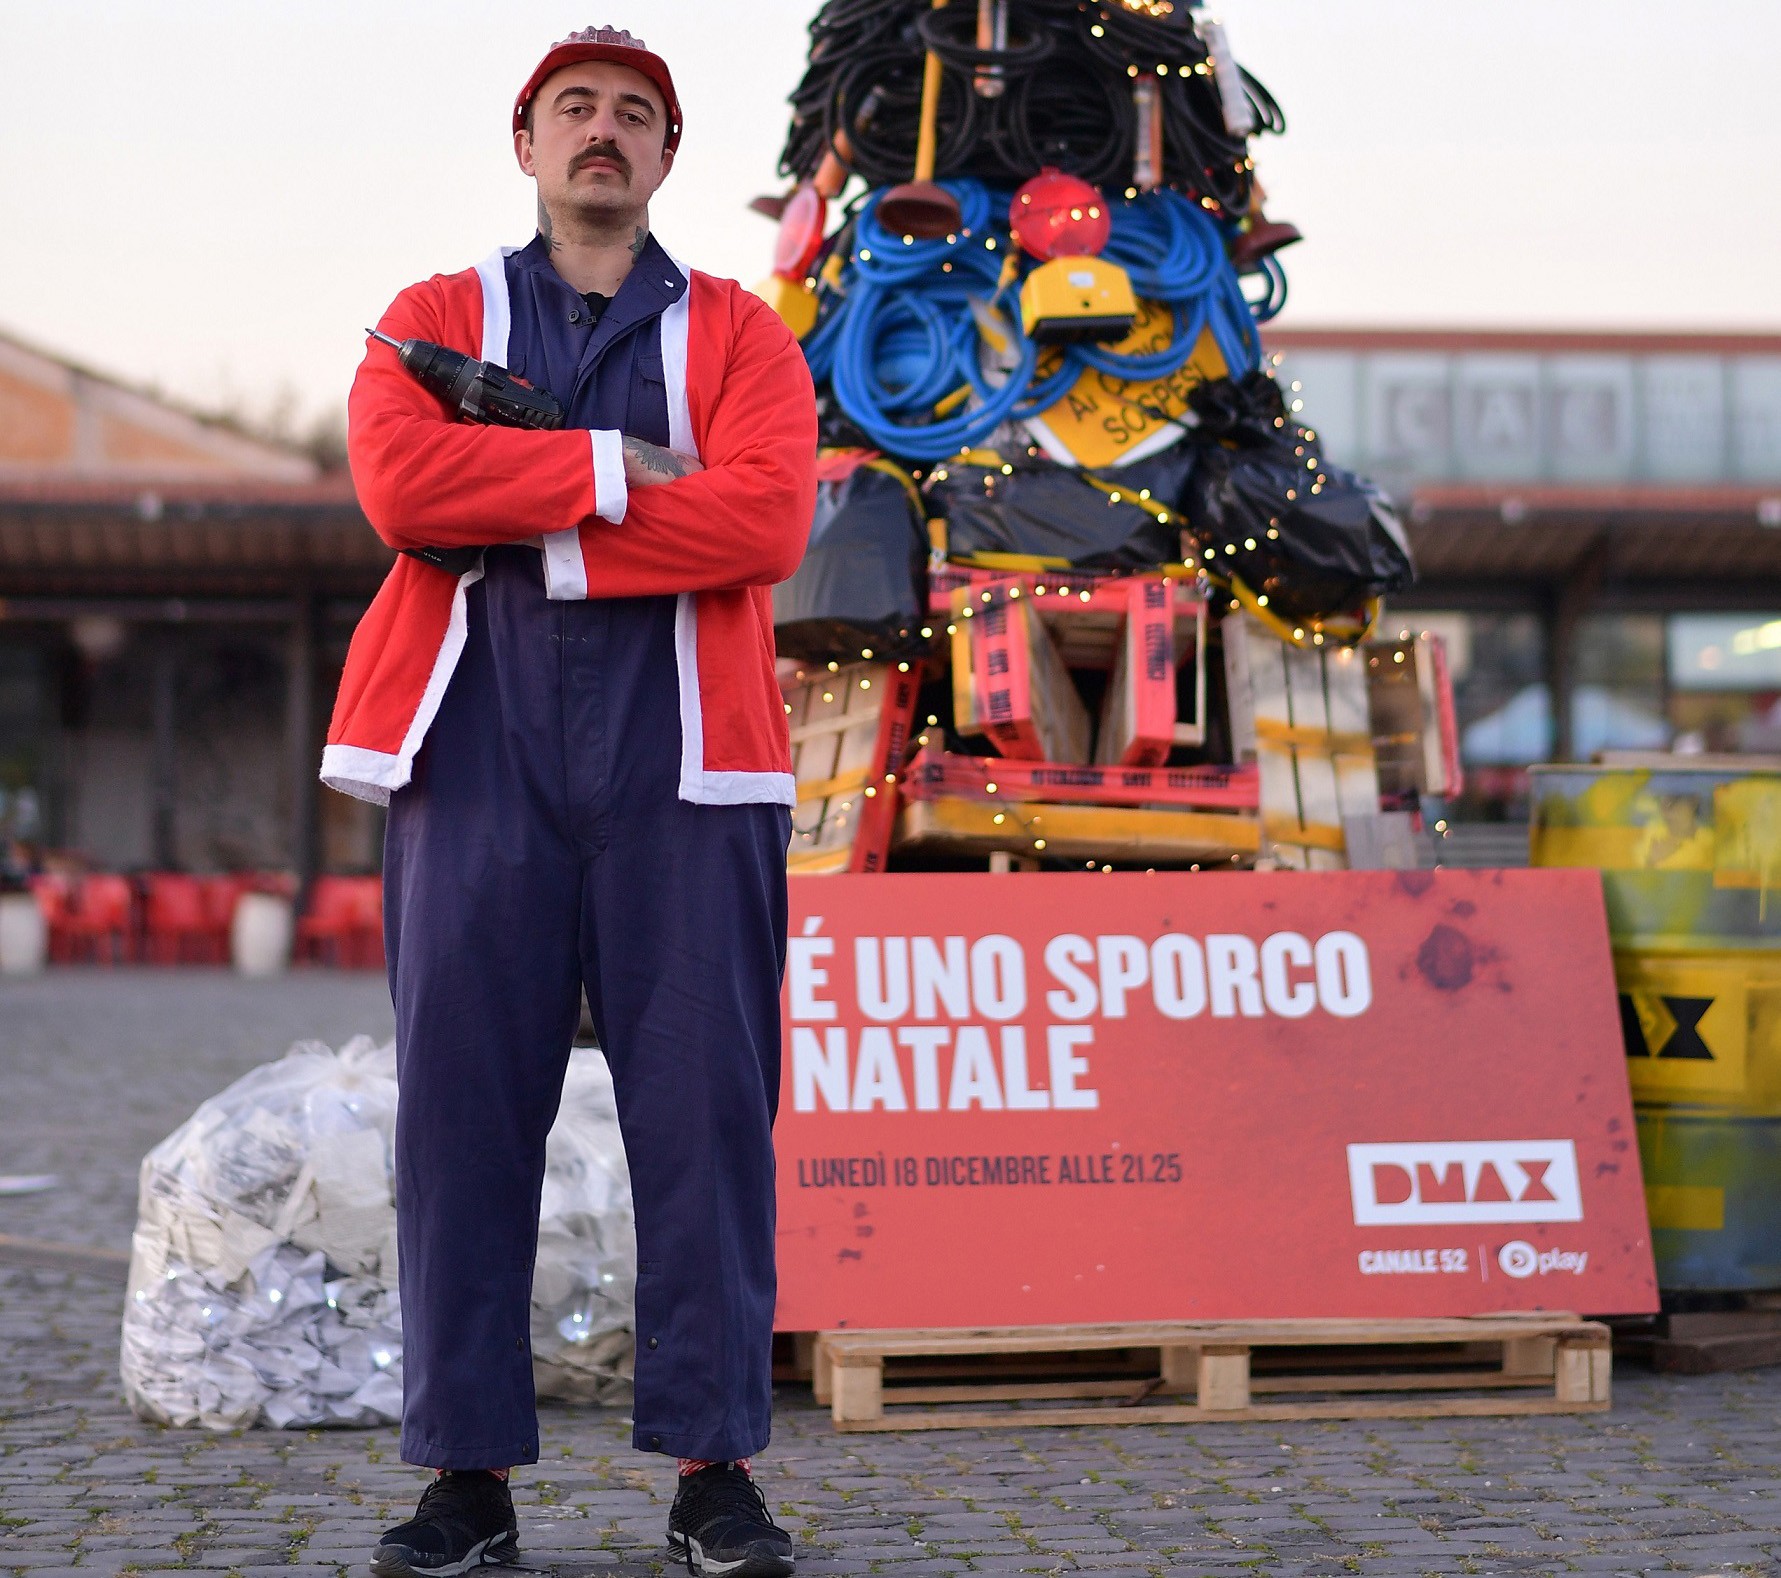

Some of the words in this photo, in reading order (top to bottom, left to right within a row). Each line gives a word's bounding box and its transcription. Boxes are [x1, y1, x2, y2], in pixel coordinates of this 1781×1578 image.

[1102, 360, 1204, 445] SOSPESI
[789, 916, 838, 1020] É
[855, 934, 1027, 1020] UNO
[1045, 931, 1373, 1020] SPORCO
[790, 1024, 1099, 1113] NATALE
[798, 1151, 886, 1188] LUNEDÌ
[894, 1156, 918, 1187] 18
[926, 1155, 1052, 1187] DICEMBRE
[1058, 1154, 1115, 1185] ALLE
[1121, 1152, 1183, 1184] 21.25
[1371, 1159, 1558, 1205] DMAX
[1357, 1249, 1439, 1275] CANALE
[1439, 1248, 1469, 1274] 52
